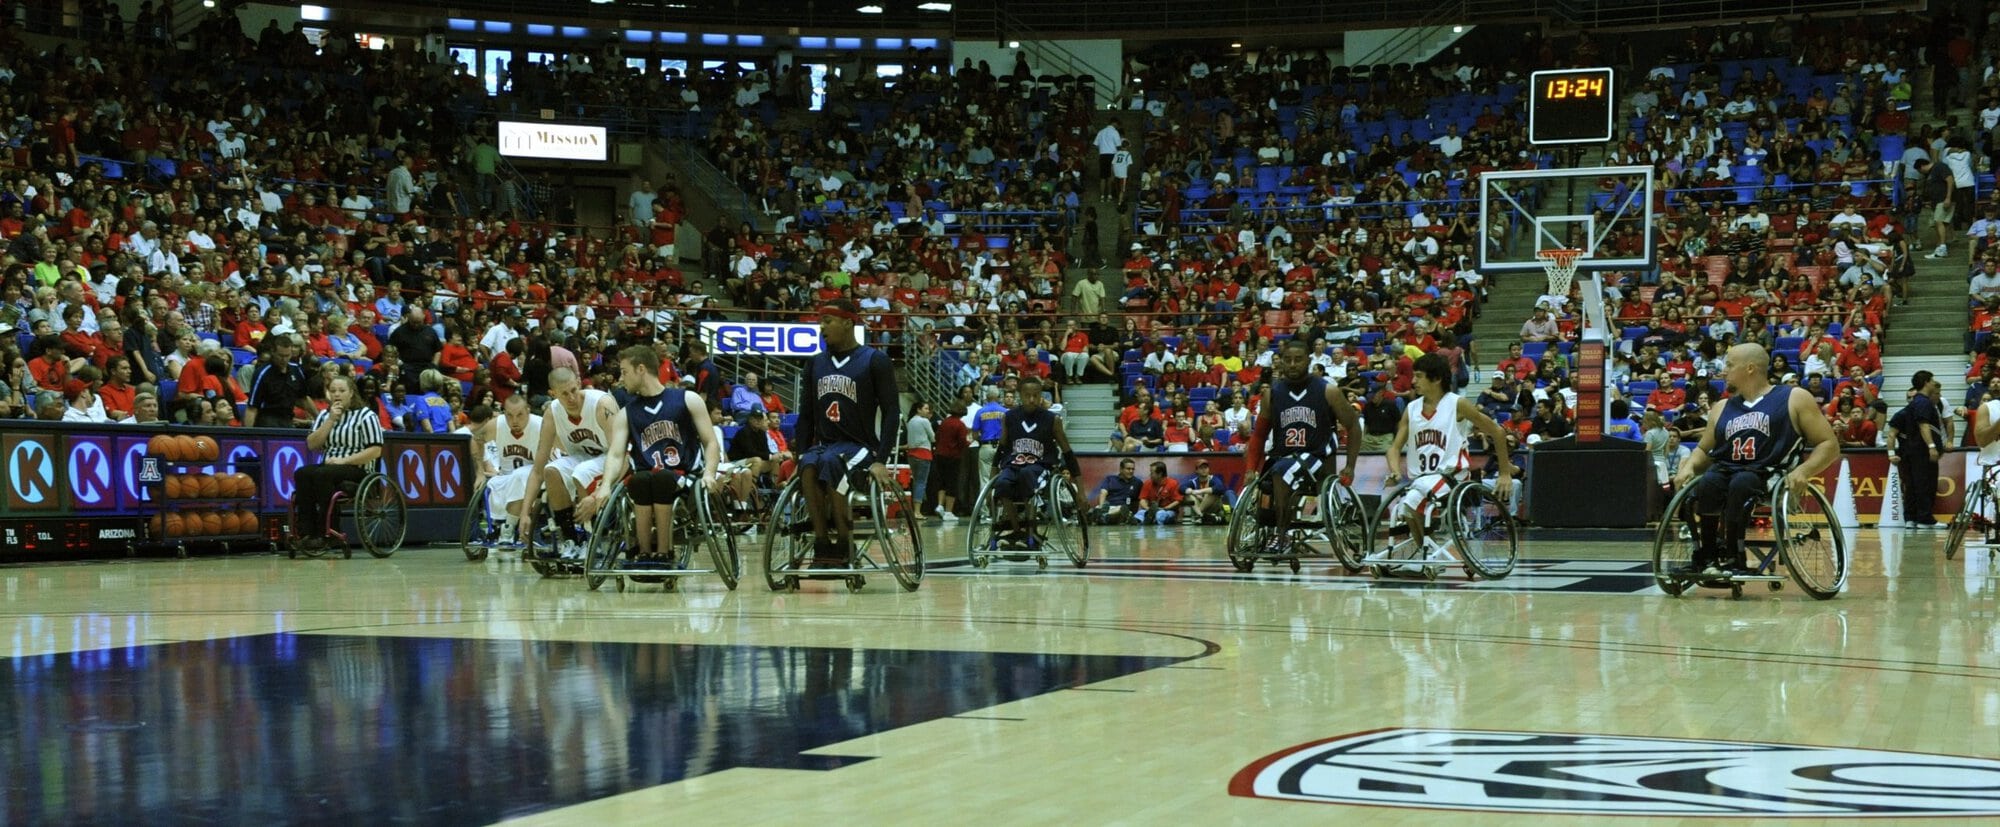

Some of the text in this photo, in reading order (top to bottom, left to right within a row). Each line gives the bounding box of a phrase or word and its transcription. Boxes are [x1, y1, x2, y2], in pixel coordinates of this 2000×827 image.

[1546, 78, 1603, 99] 13:24
[716, 325, 827, 353] GEIC
[818, 374, 857, 403] ARIZONA
[826, 401, 840, 422] 4
[1280, 405, 1317, 428] ARIZONA
[641, 419, 683, 452] ARIZONA
[1725, 411, 1770, 440] ARIZONA
[567, 428, 604, 448] ARIZONA
[1011, 437, 1044, 458] ARIZONA
[1285, 428, 1306, 447] 21
[1414, 428, 1447, 451] ARIZONA
[1732, 436, 1755, 460] 14
[503, 444, 534, 461] ARIZONA
[652, 446, 680, 469] 13
[1418, 453, 1440, 472] 30
[139, 458, 162, 481] A
[99, 529, 136, 539] ARIZONA
